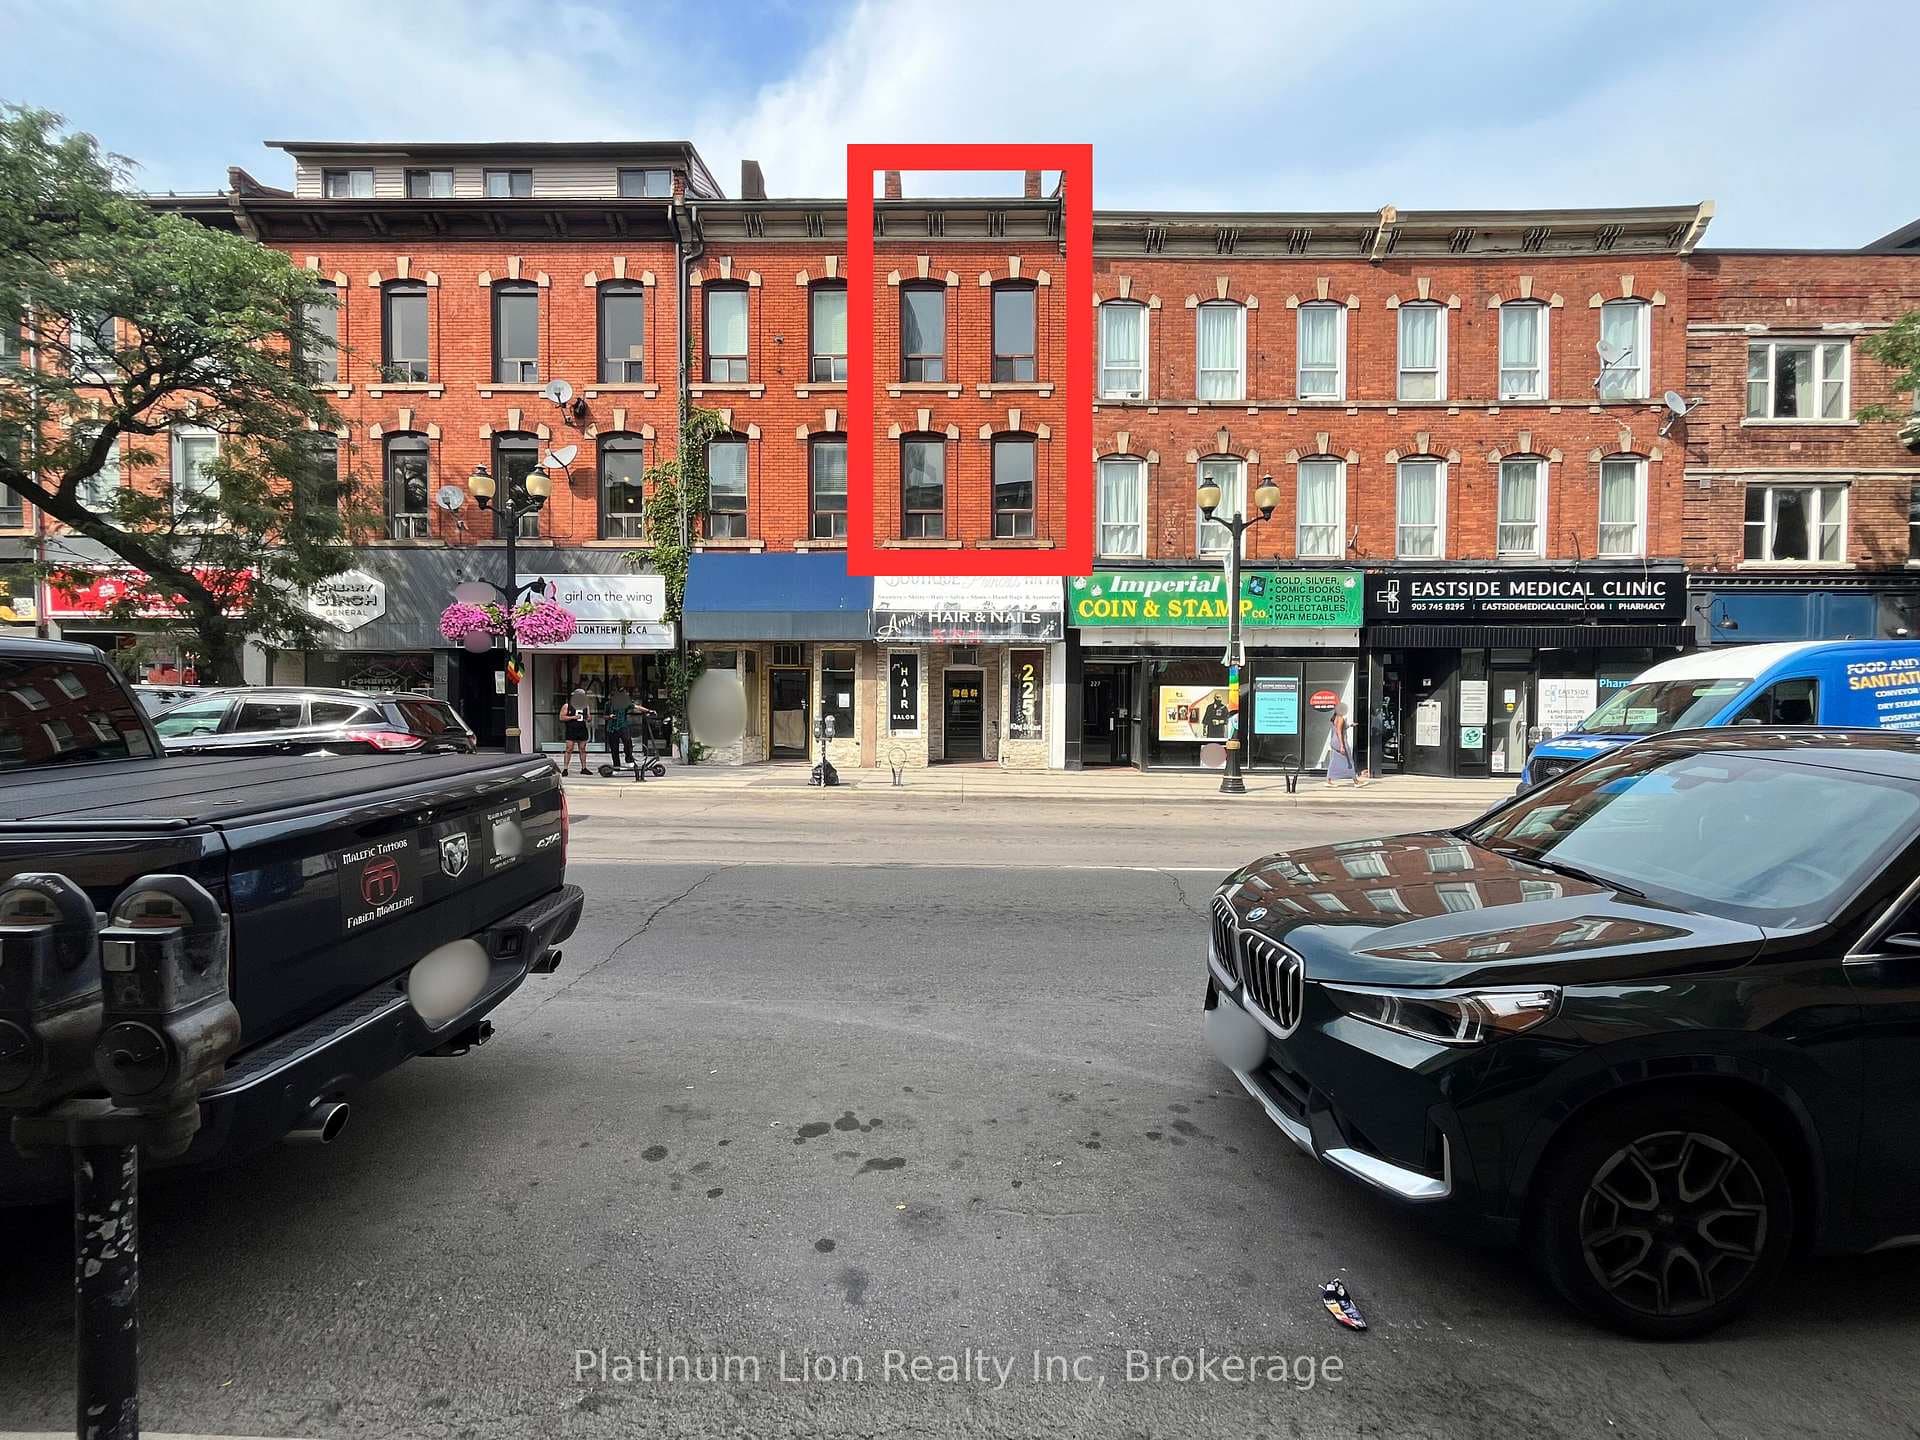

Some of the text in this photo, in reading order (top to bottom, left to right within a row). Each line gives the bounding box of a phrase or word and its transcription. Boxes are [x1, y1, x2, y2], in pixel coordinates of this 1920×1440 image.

[1109, 576, 1220, 597] Imperial
[1275, 577, 1340, 586] GOLD, SILVER,
[1275, 586, 1344, 595] COMIC BOOKS,
[1411, 581, 1666, 597] EASTSIDE MEDICAL CLINIC
[564, 590, 653, 604] girl on the wing
[1275, 595, 1349, 604] SPORTS CARDS,
[1078, 600, 1138, 617] COIN
[1143, 599, 1161, 617] &
[1168, 599, 1253, 618] STAMP
[1275, 603, 1348, 613] COLLECTABLES,
[1411, 602, 1427, 611] 905
[1428, 602, 1443, 611] 745
[1444, 602, 1465, 611] 8295
[1618, 602, 1666, 611] PHARMACY
[928, 611, 971, 623] HAIR
[974, 611, 986, 623] &
[990, 611, 1042, 624] NAILS
[1275, 613, 1336, 621] WAR MEDALS
[1847, 658, 1919, 675] FOOD AND
[900, 667, 909, 709] HAIR
[1021, 663, 1035, 716] 225
